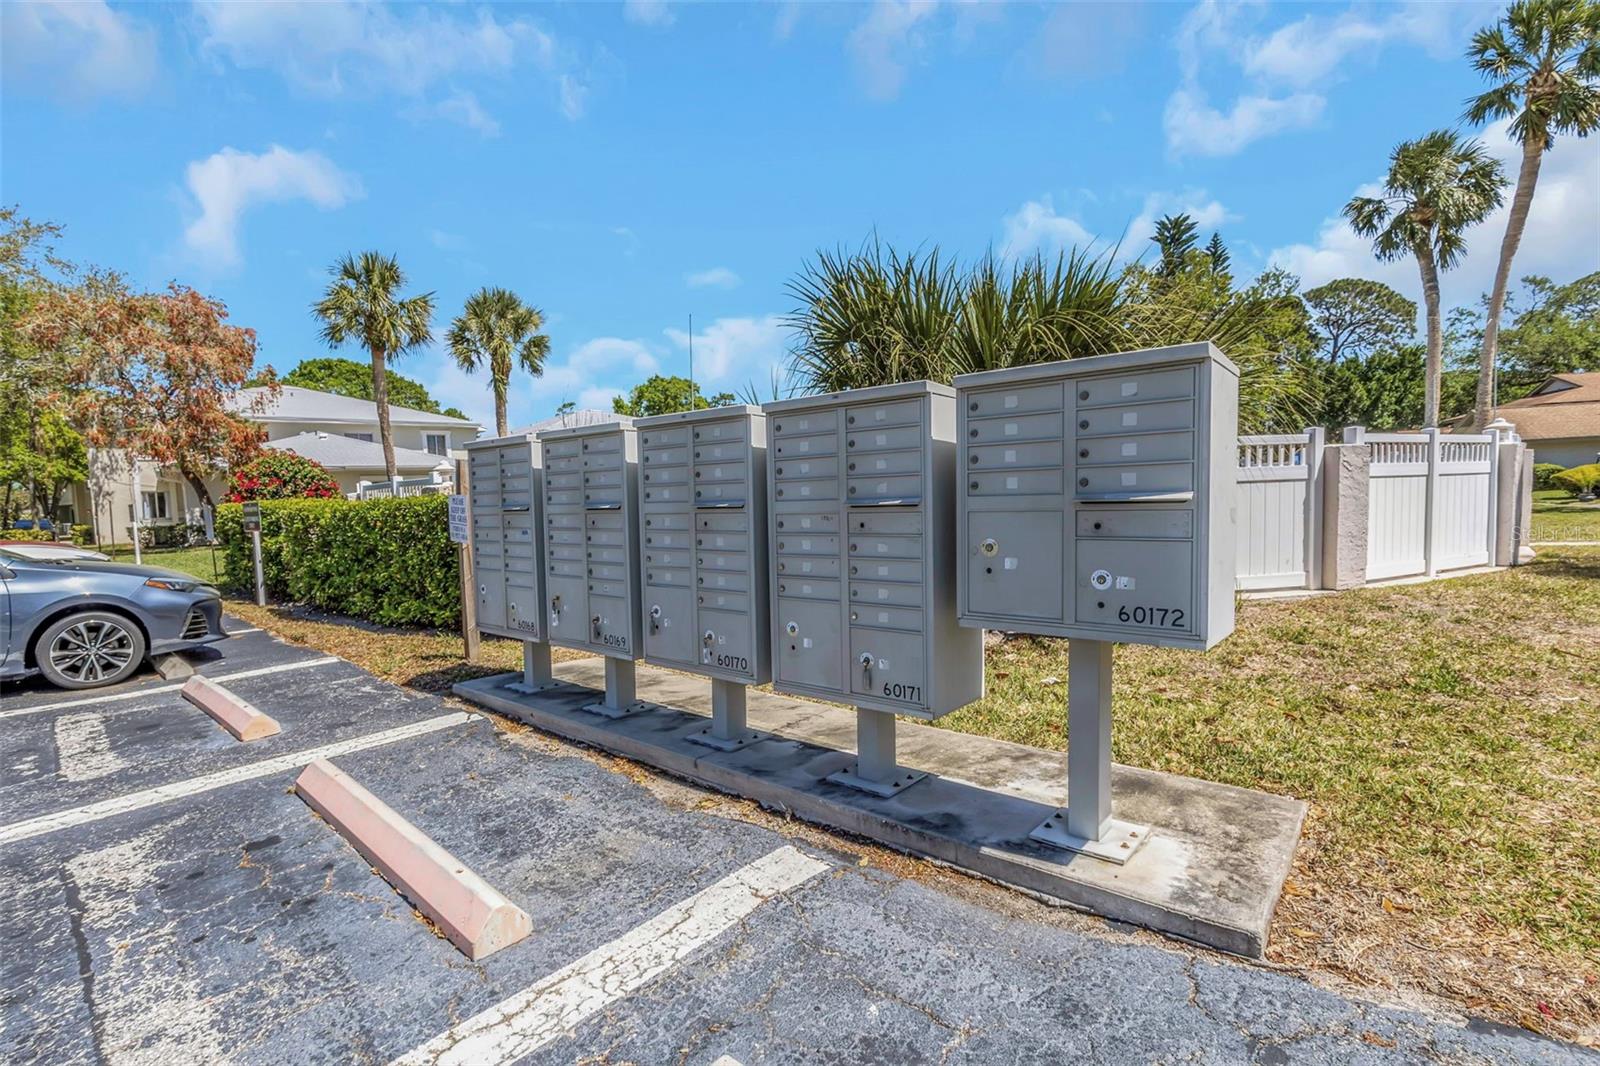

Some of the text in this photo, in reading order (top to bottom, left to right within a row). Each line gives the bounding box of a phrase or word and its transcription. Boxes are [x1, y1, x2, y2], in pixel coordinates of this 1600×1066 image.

[1119, 605, 1185, 628] 60172
[518, 621, 535, 632] 60168
[604, 634, 626, 647] 60169
[718, 654, 748, 670] 60170
[883, 682, 921, 702] 60171
